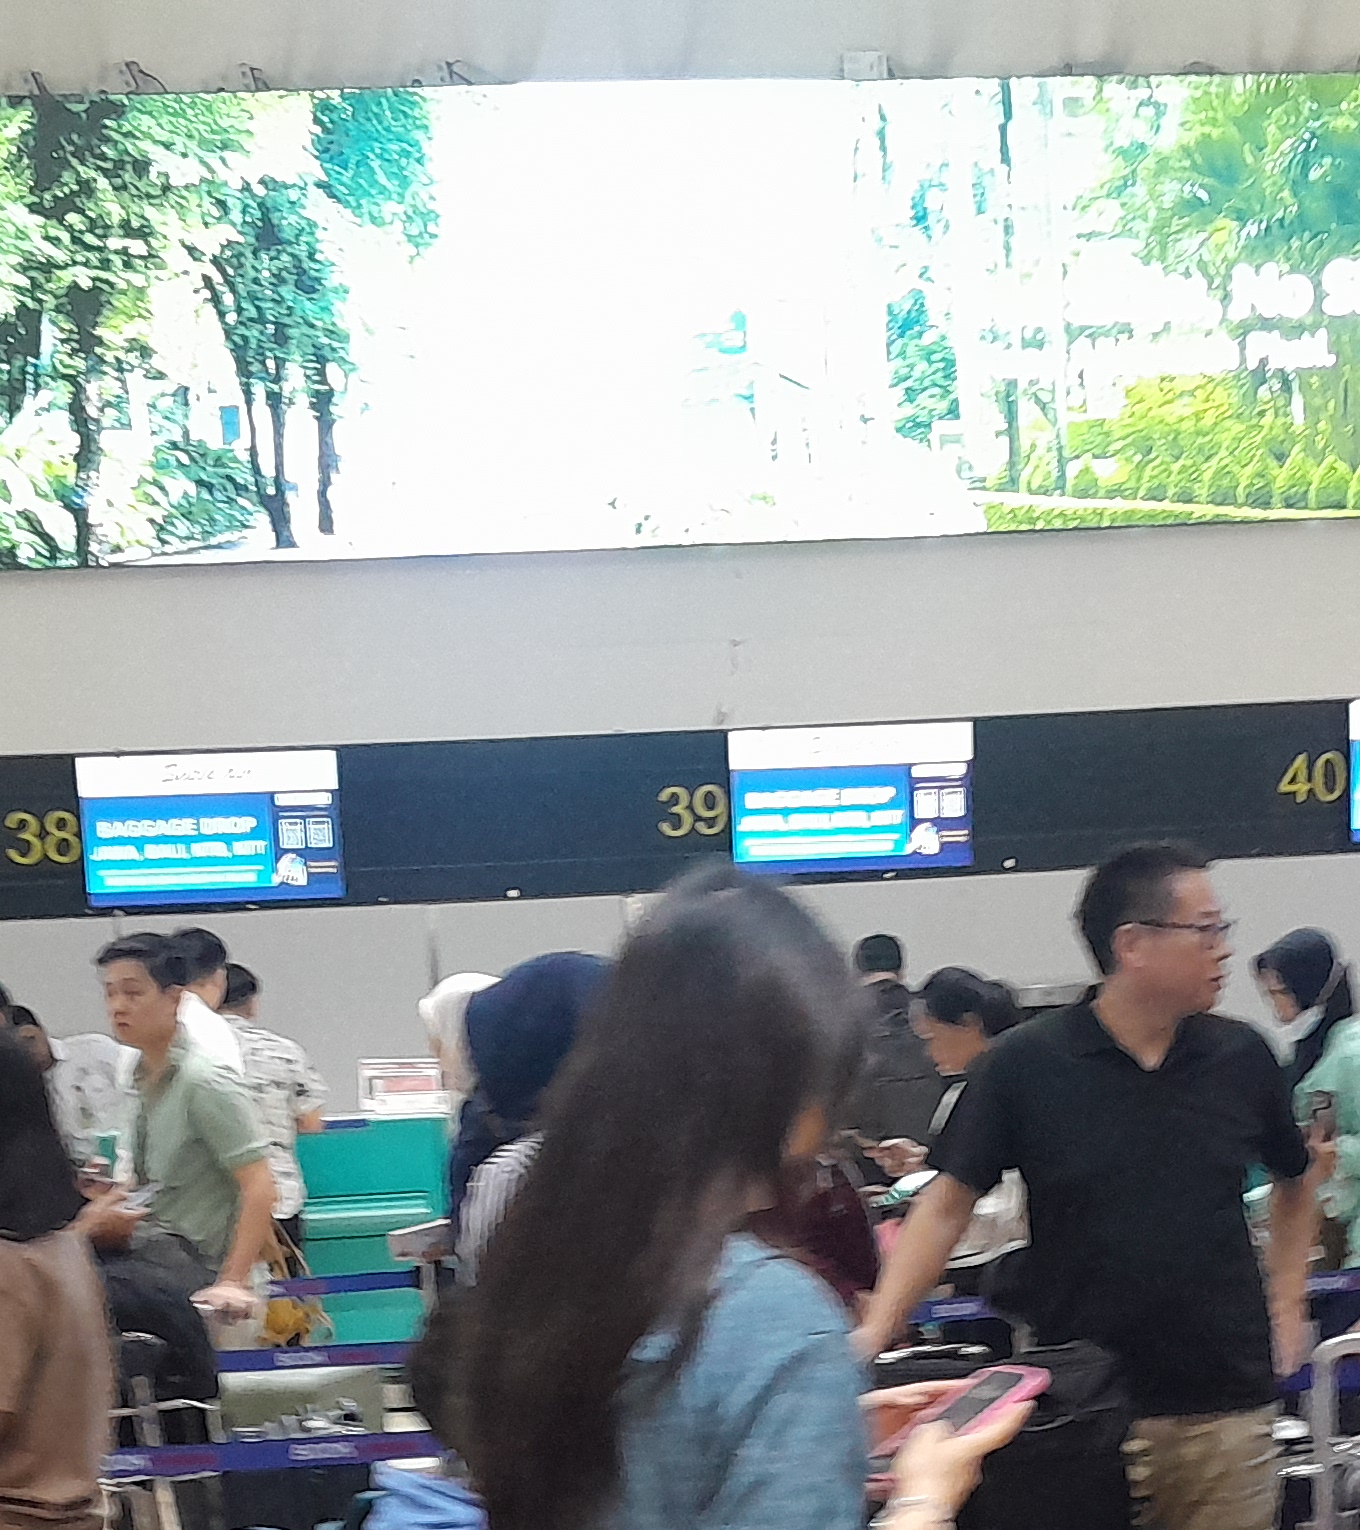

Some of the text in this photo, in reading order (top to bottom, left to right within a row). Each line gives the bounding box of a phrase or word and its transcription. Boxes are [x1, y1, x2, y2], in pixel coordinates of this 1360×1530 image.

[1276, 750, 1347, 804] 40
[657, 784, 727, 837] 39
[4, 811, 81, 865] 38
